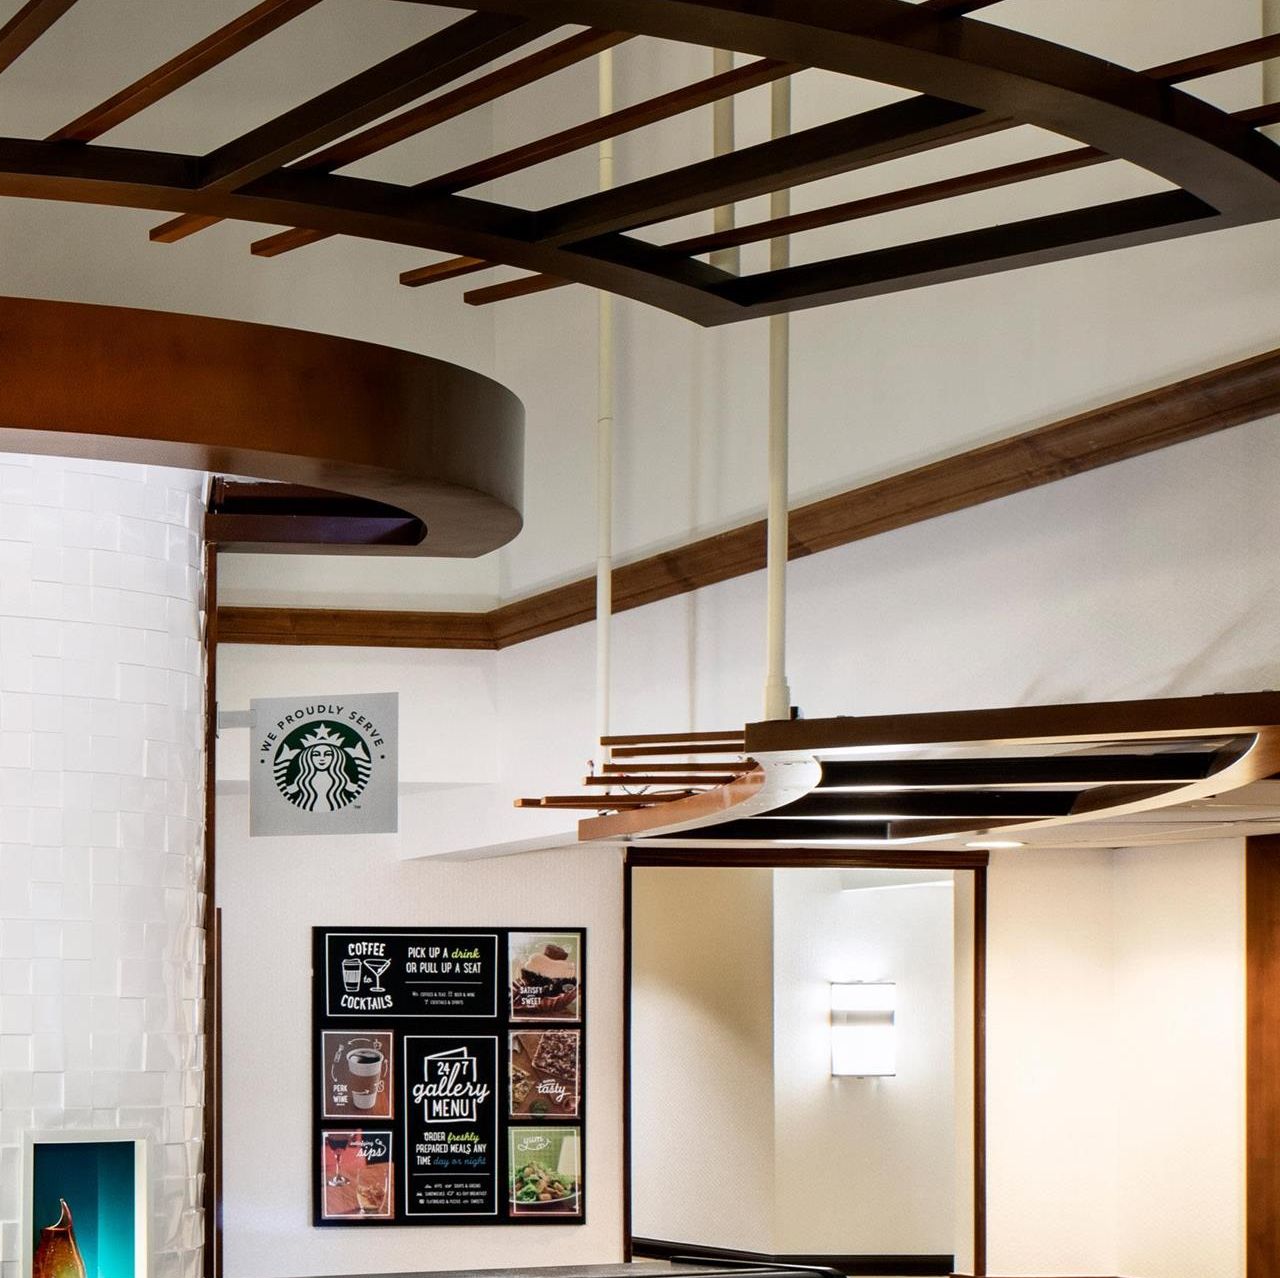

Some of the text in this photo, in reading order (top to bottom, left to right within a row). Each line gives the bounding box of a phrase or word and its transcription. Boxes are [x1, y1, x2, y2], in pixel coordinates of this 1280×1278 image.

[261, 704, 384, 752] WE PROUDLY SERVE
[348, 941, 386, 957] COFFEE
[407, 947, 480, 959] PICK UP A drink
[405, 962, 481, 974] OR PULL UP A SEAT
[363, 976, 373, 984] to
[340, 994, 393, 1010] COCKTAILS
[521, 997, 542, 1005] SWEET
[333, 1084, 348, 1092] PERK
[412, 1062, 491, 1104] gallery
[536, 1082, 572, 1102] tasty
[333, 1095, 348, 1103] WINE
[432, 1099, 470, 1117] MENU
[423, 1131, 480, 1144] ORDER freshly
[356, 1141, 386, 1160] sips
[415, 1143, 487, 1155] PREPARED MEALS ANY
[416, 1155, 432, 1166] TIME
[433, 1156, 450, 1168] day
[464, 1156, 487, 1168] night
